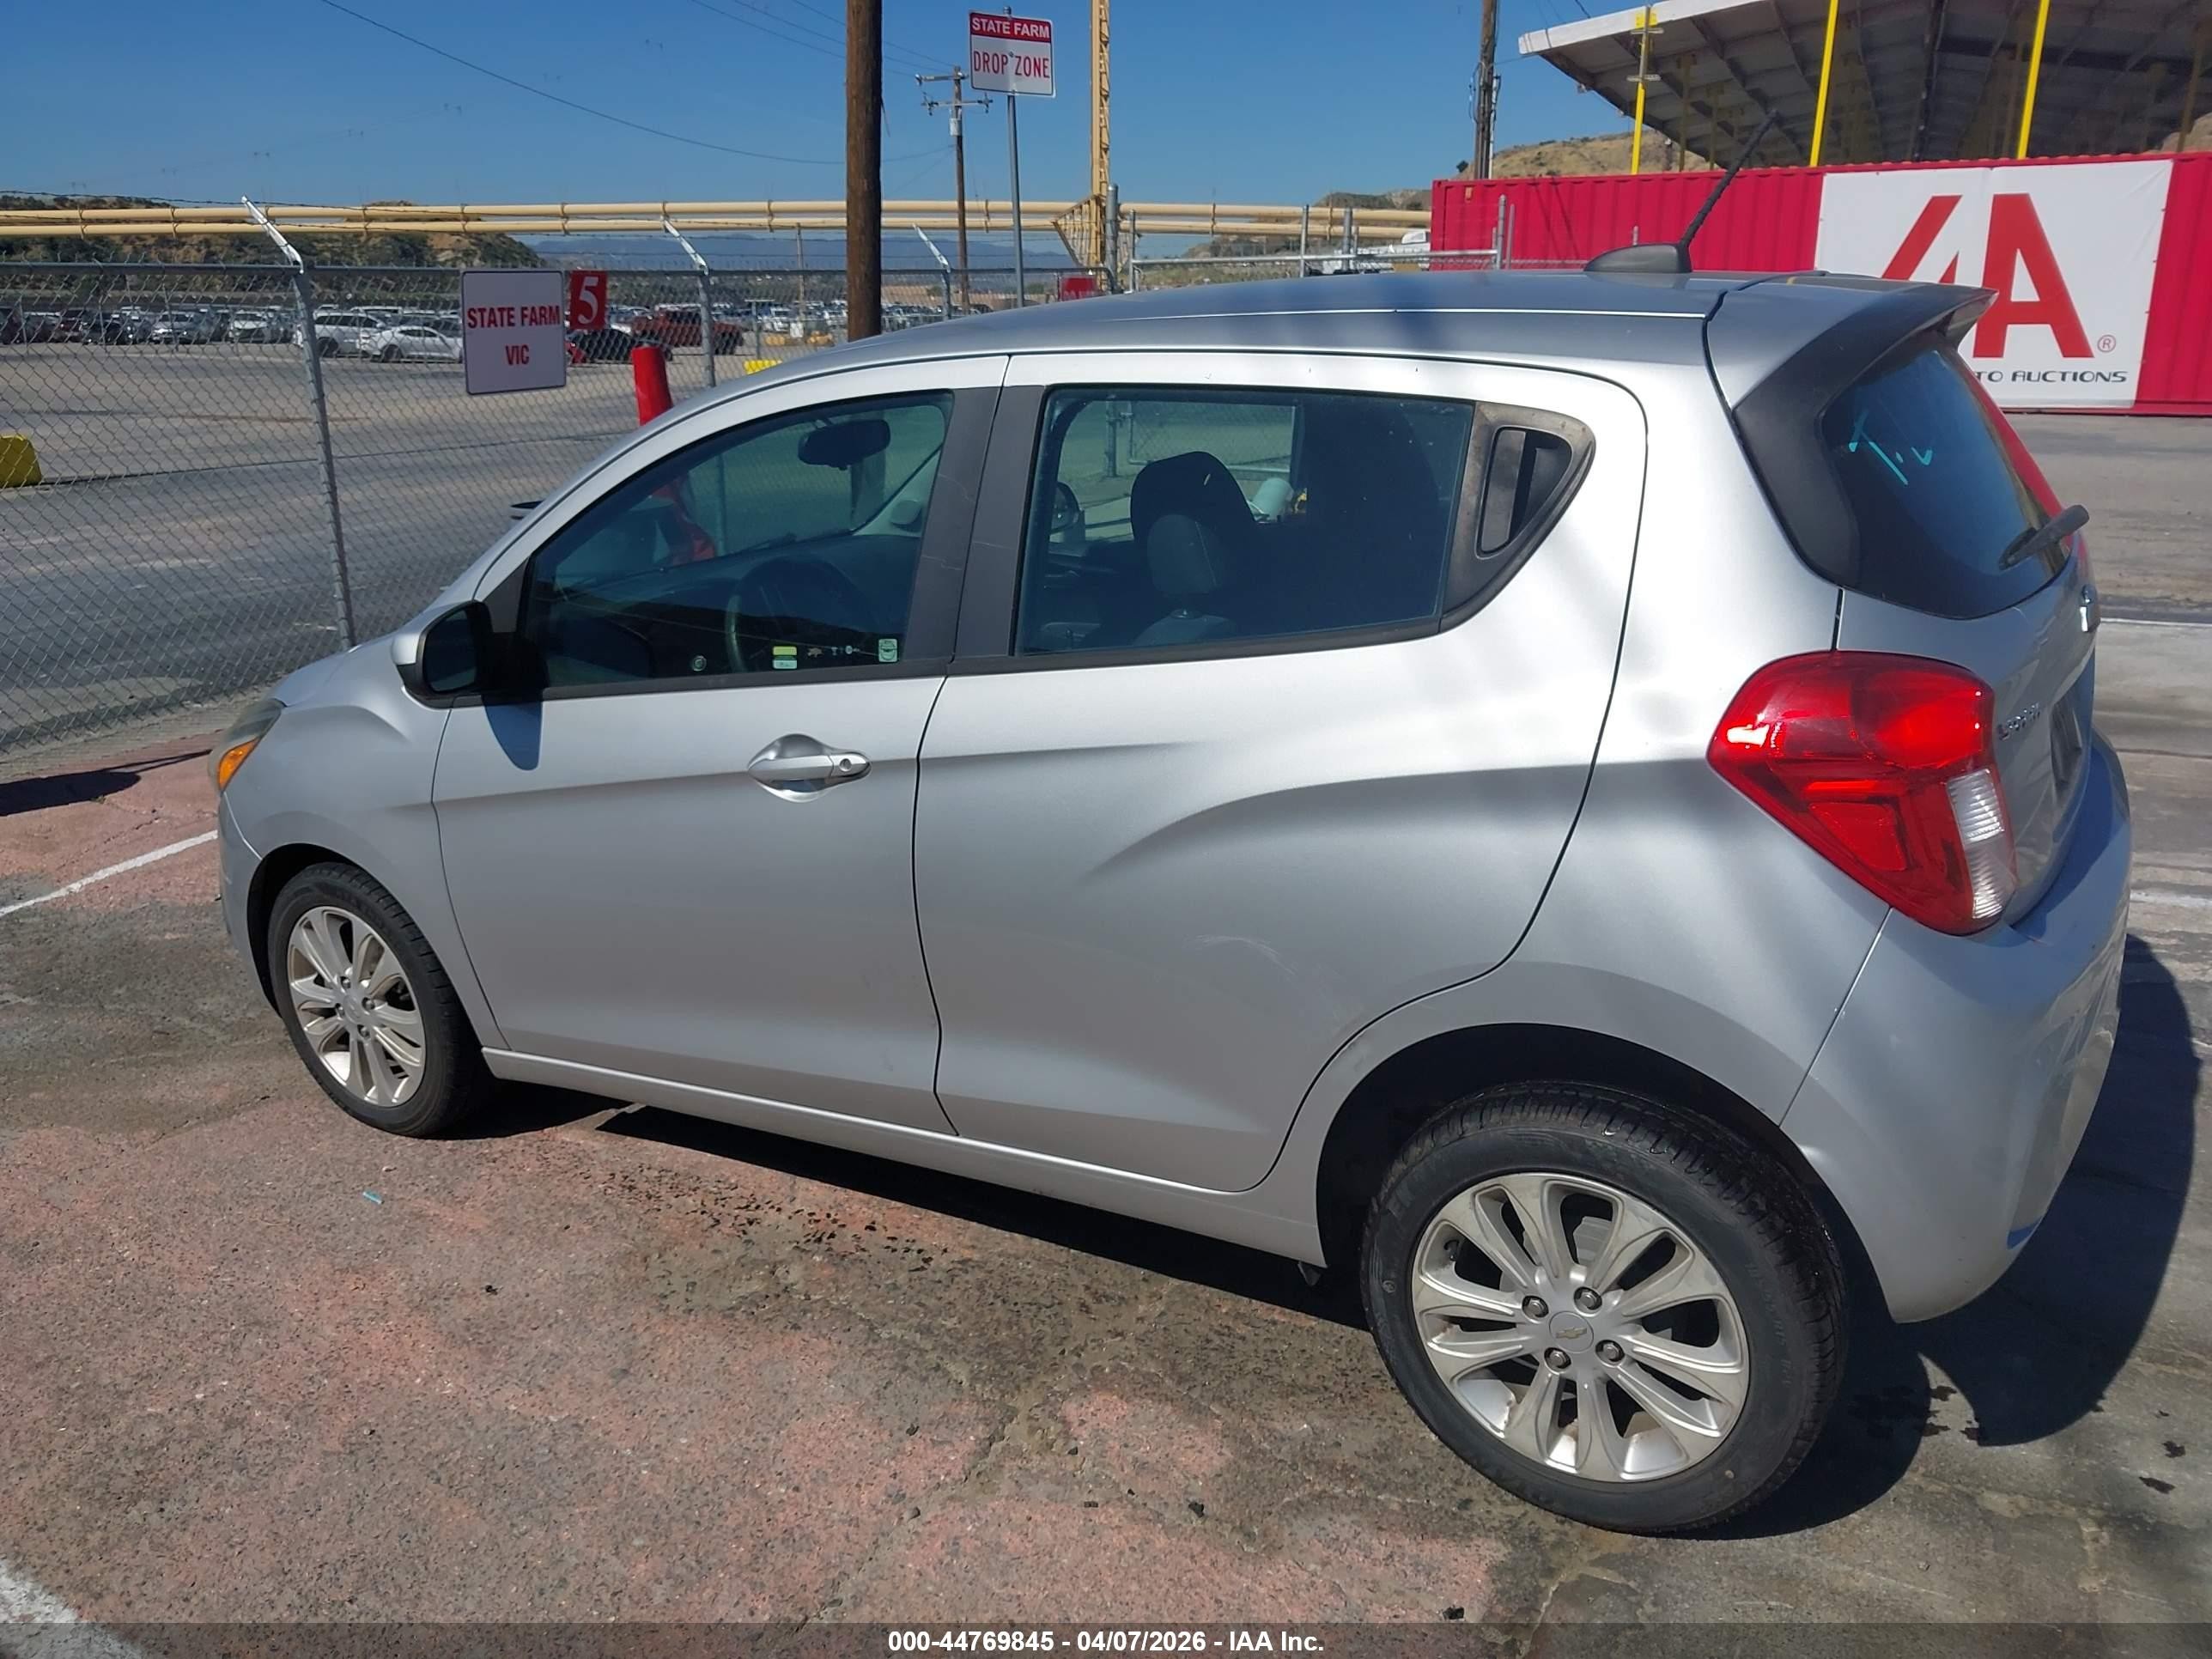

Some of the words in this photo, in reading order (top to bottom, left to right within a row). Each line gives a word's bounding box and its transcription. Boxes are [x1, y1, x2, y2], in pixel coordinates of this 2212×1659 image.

[972, 17, 1011, 34] STATE
[1015, 22, 1049, 39] FARM
[974, 51, 1008, 75] DROP
[1015, 56, 1049, 78] ZONE
[579, 276, 599, 325] 5
[468, 307, 515, 329] STATE
[520, 305, 560, 326] FARM
[505, 344, 530, 366] VIC
[1975, 370, 2003, 383] TO
[2011, 370, 2129, 383] AUCTIONS
